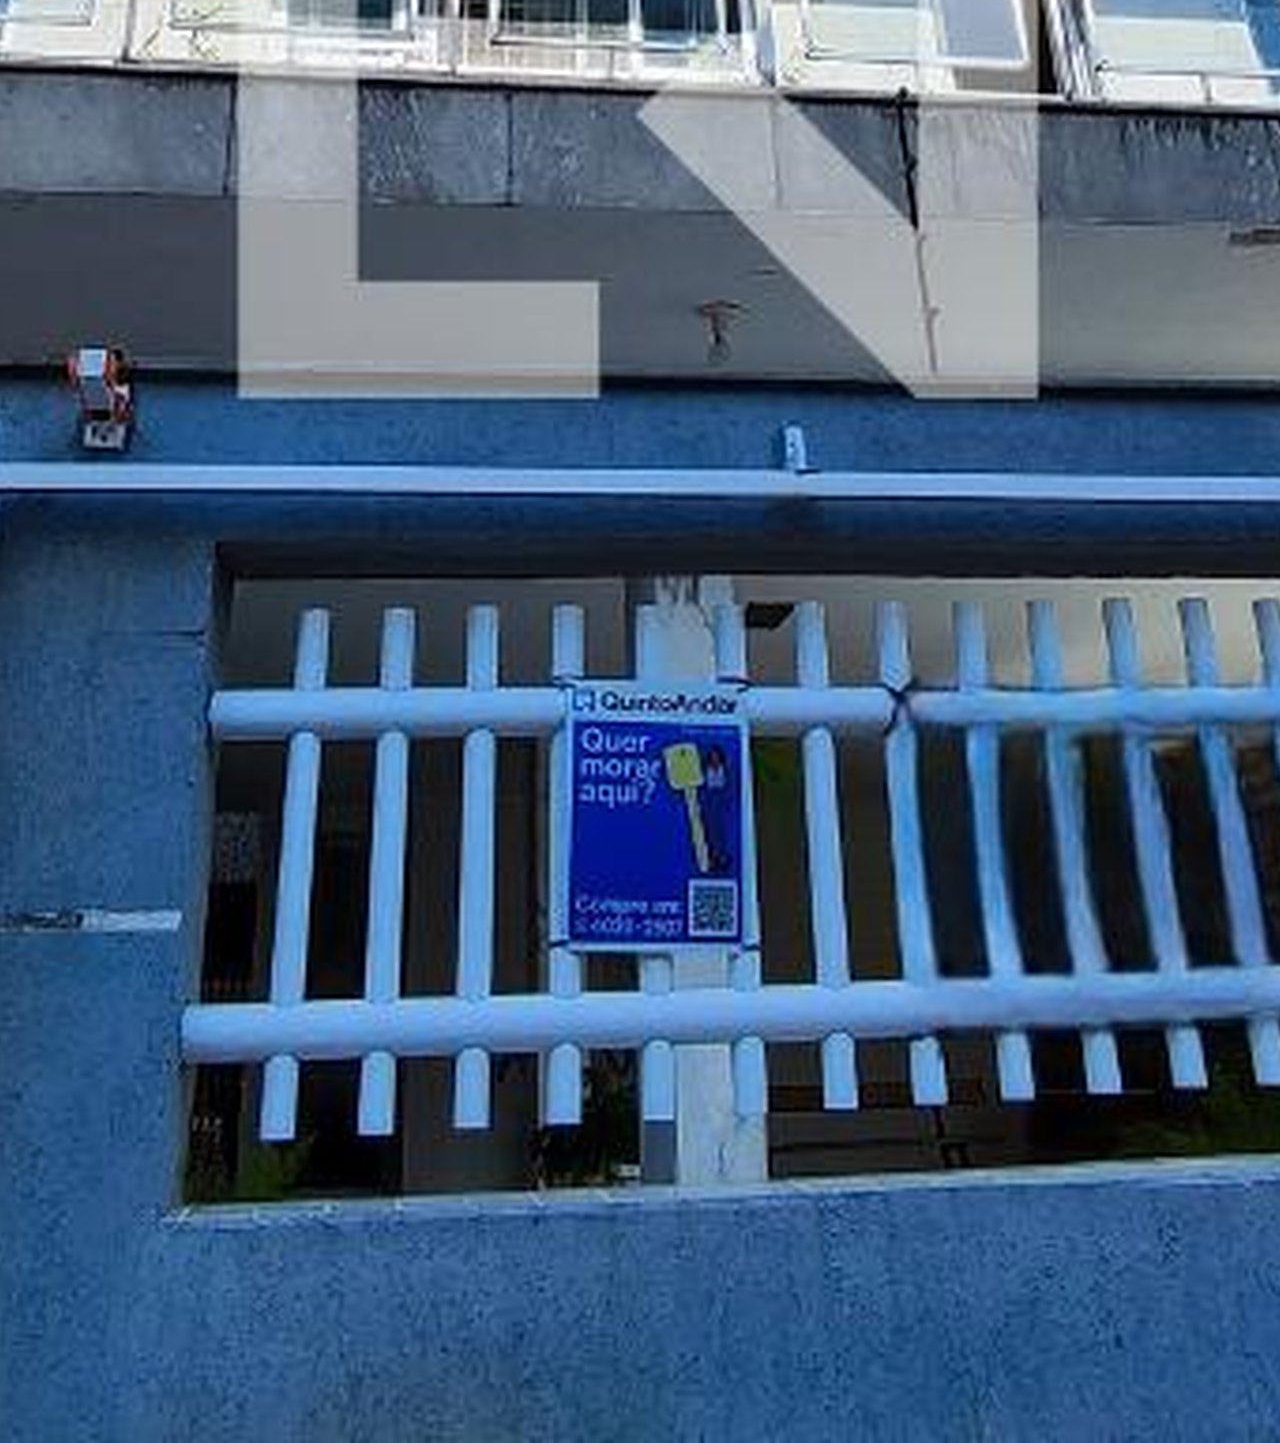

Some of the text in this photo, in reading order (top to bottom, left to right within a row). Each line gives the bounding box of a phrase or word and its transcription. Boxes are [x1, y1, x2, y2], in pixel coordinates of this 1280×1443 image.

[601, 691, 737, 714] QuintoAndar
[581, 727, 651, 753] Quer
[579, 779, 656, 808] aqui?
